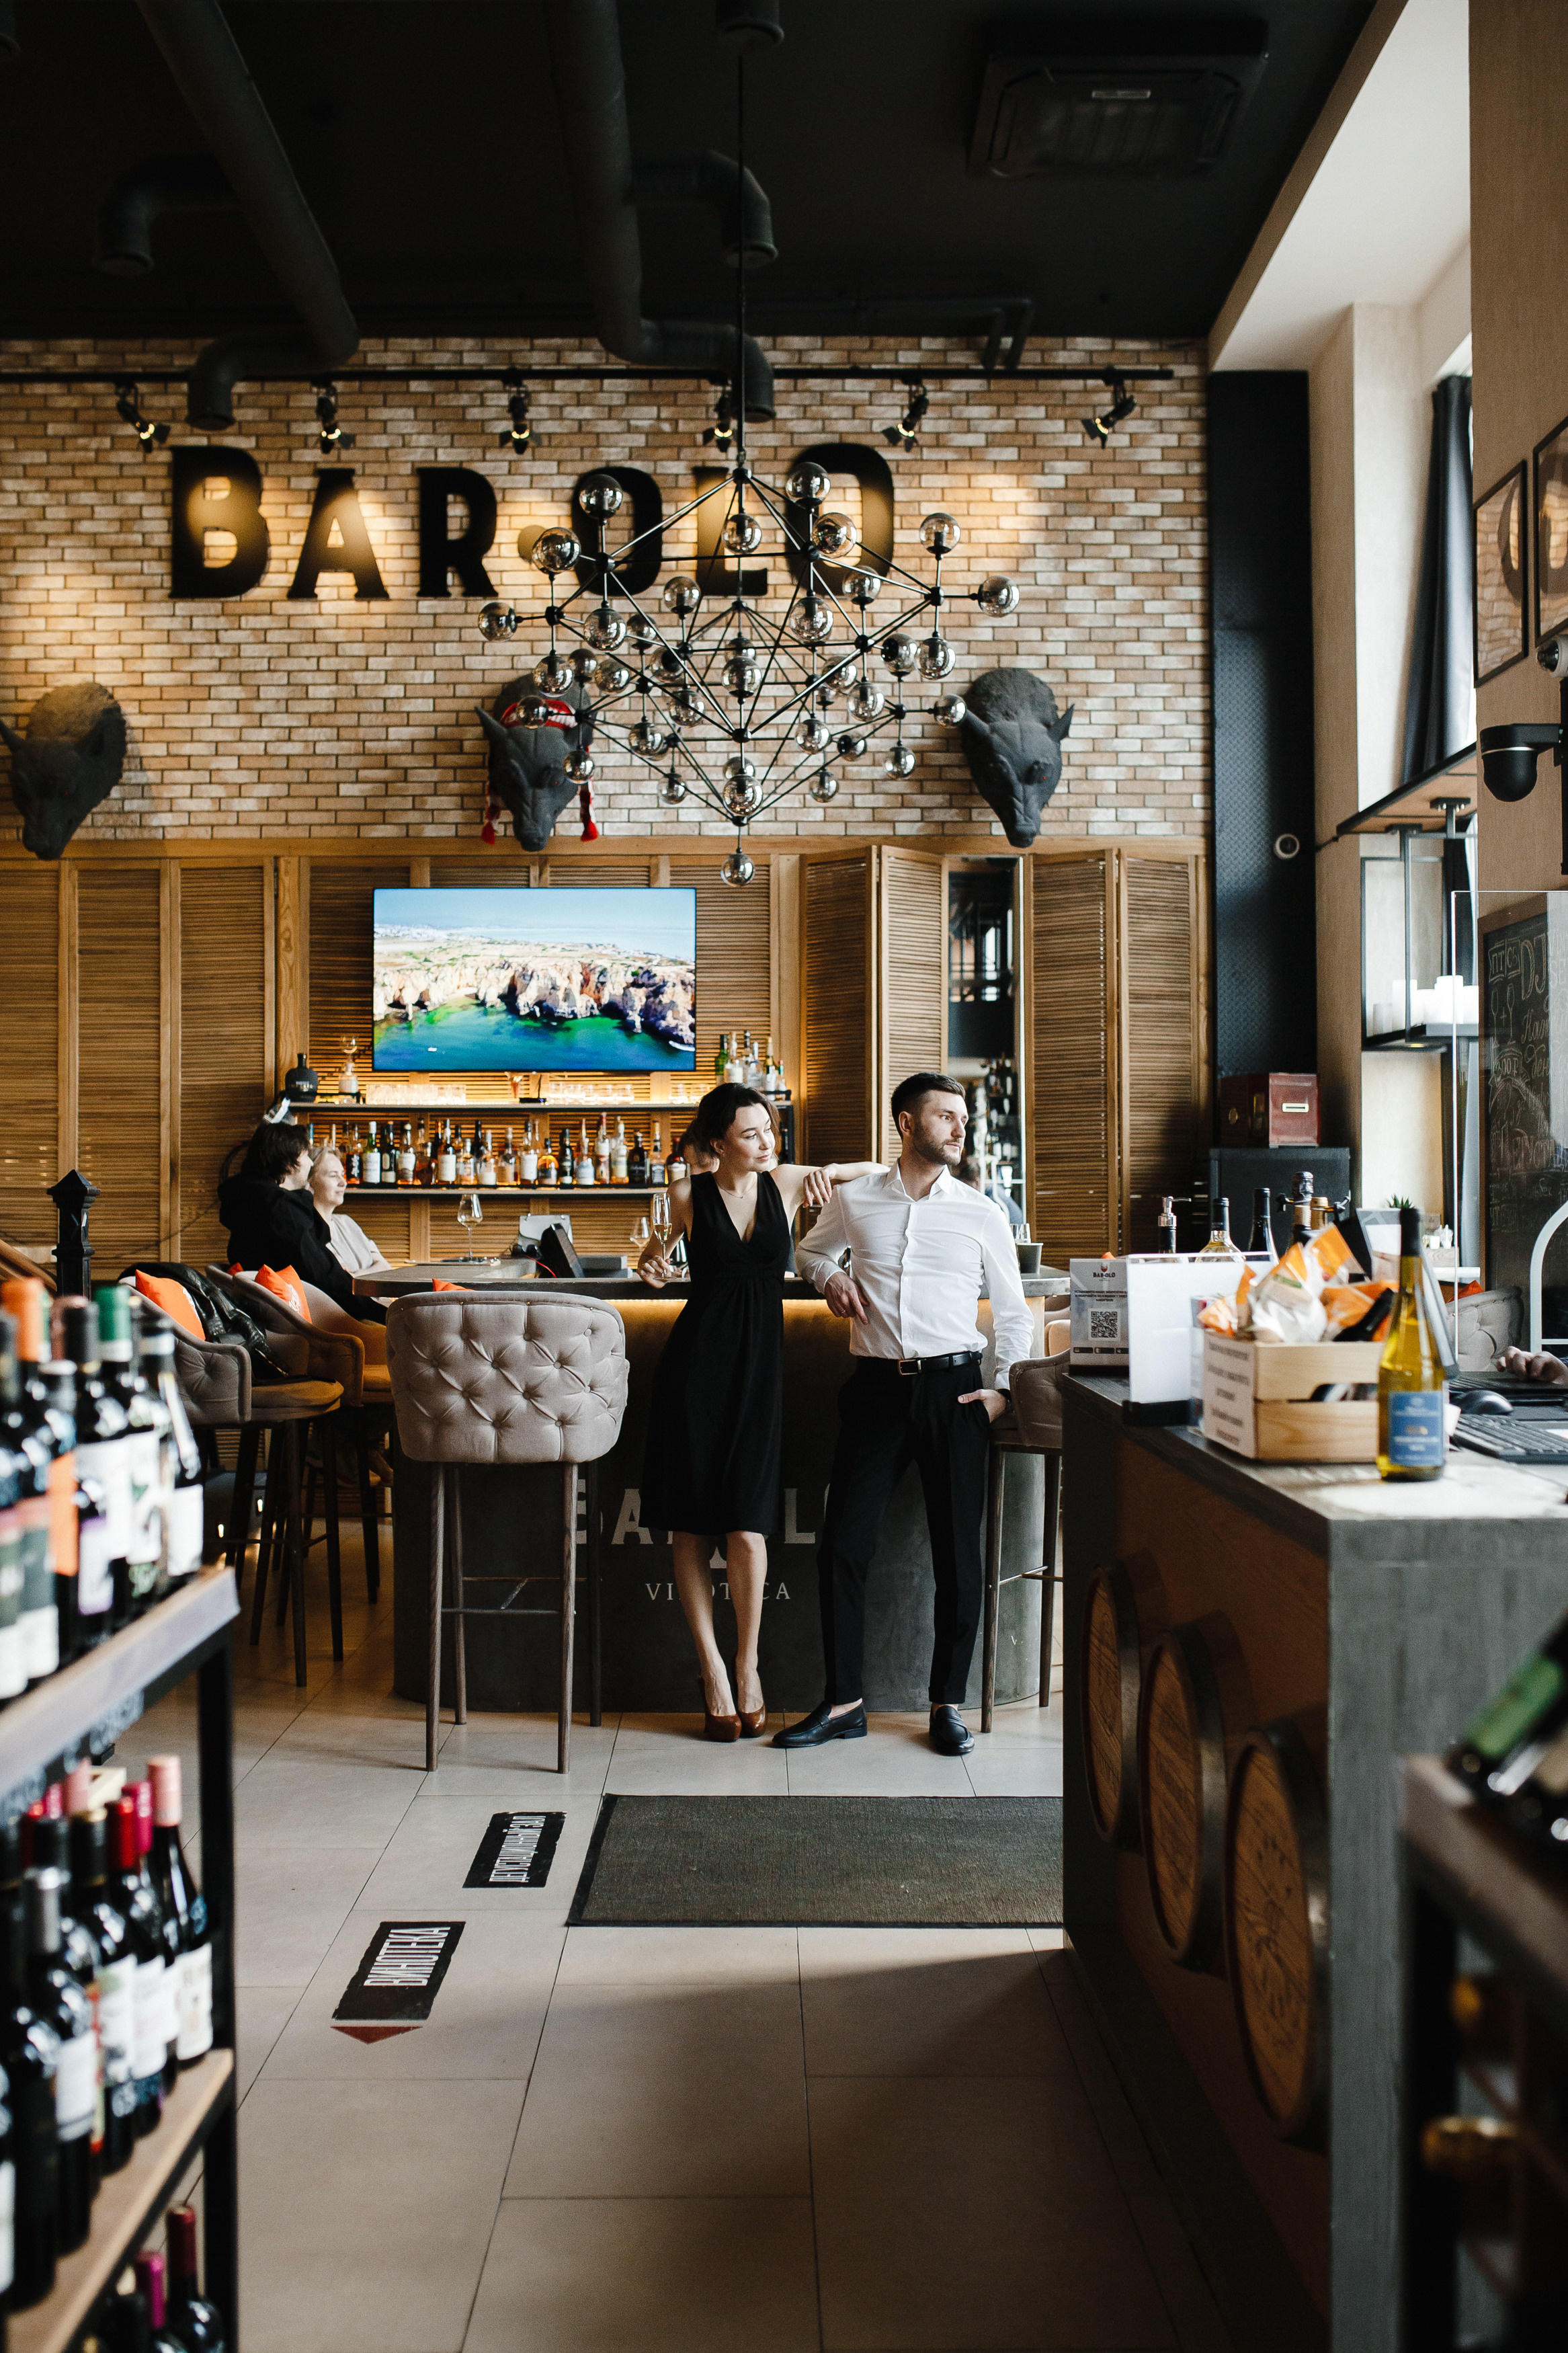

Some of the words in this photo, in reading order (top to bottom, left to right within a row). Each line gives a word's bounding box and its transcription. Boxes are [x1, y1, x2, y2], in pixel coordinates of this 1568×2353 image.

[509, 1815, 546, 1829] ЗАЛ
[489, 1828, 544, 1883] ДЕГУСТАЦИОННЫЙ
[363, 1926, 451, 1987] ВИНОТЕКА
